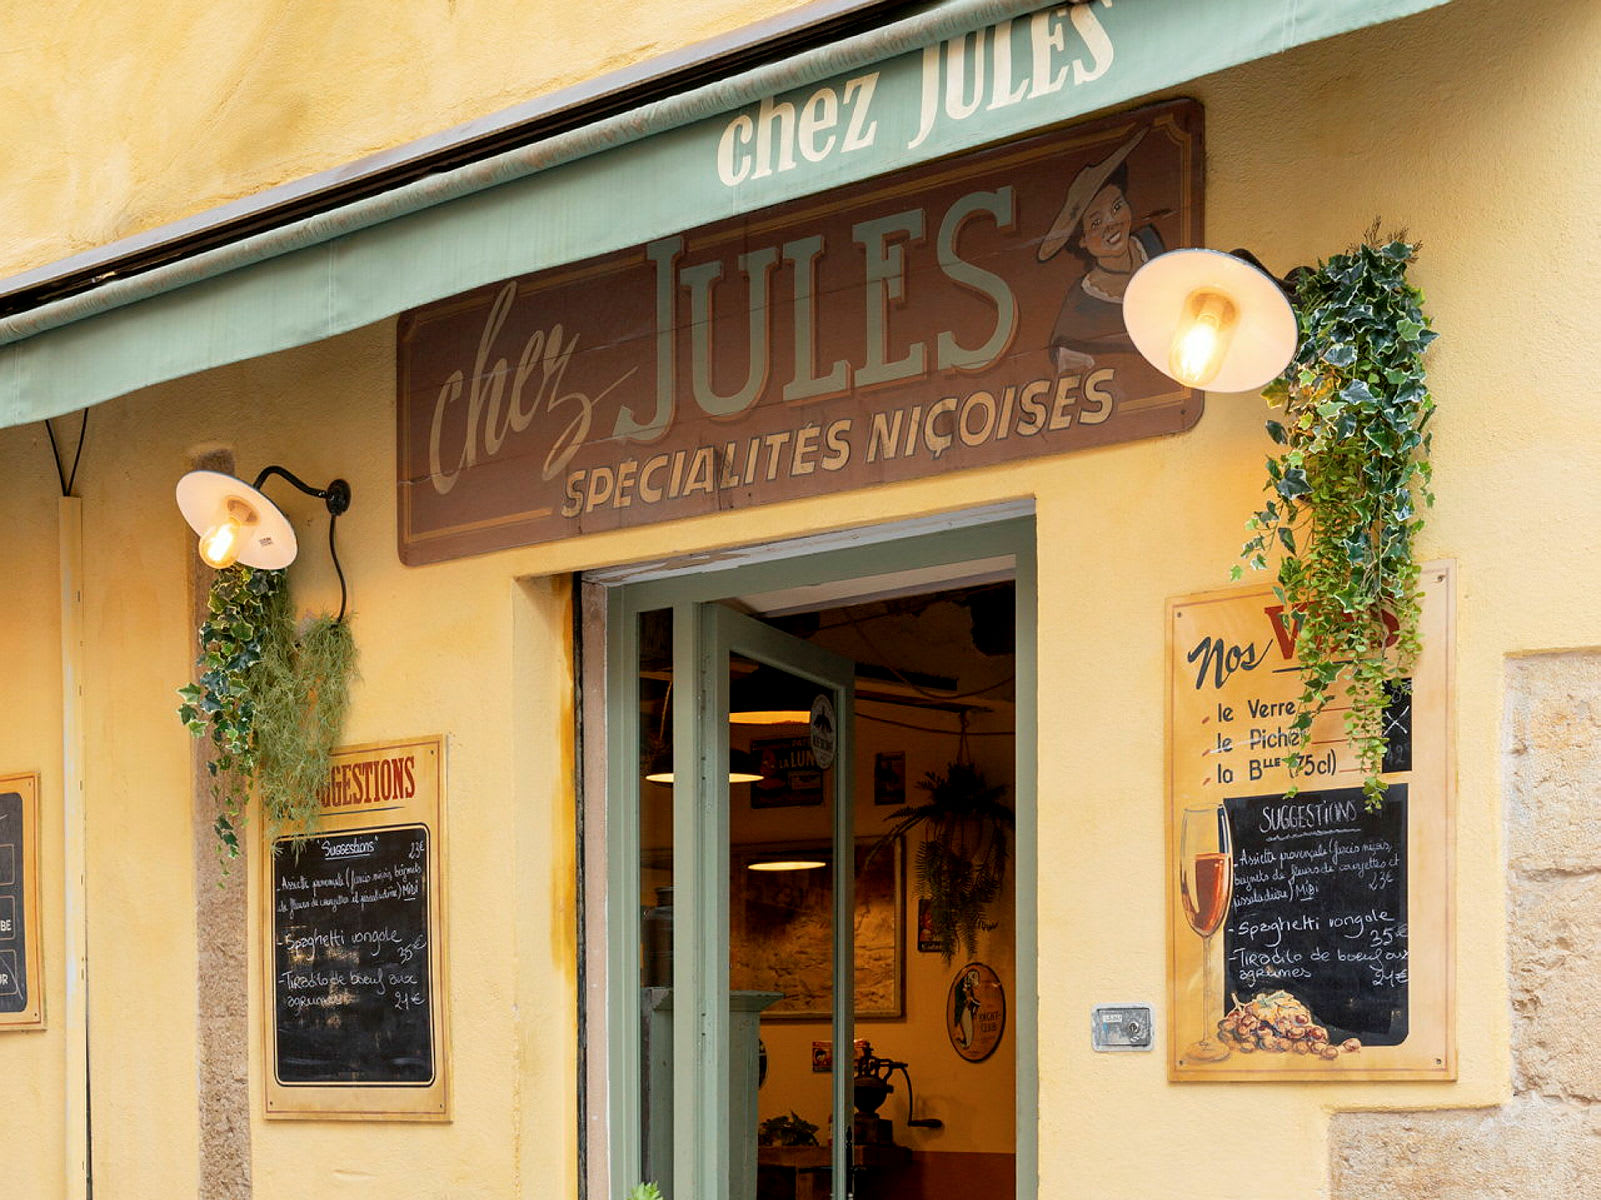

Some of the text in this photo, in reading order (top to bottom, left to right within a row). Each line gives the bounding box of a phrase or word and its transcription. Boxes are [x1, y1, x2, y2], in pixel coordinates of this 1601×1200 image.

[717, 2, 1114, 187] chez JULES
[429, 185, 1016, 495] chez JULES
[866, 367, 1117, 461] NIÇOISES
[1217, 699, 1296, 723] le Verre
[1217, 733, 1234, 753] le
[1310, 947, 1331, 962] de
